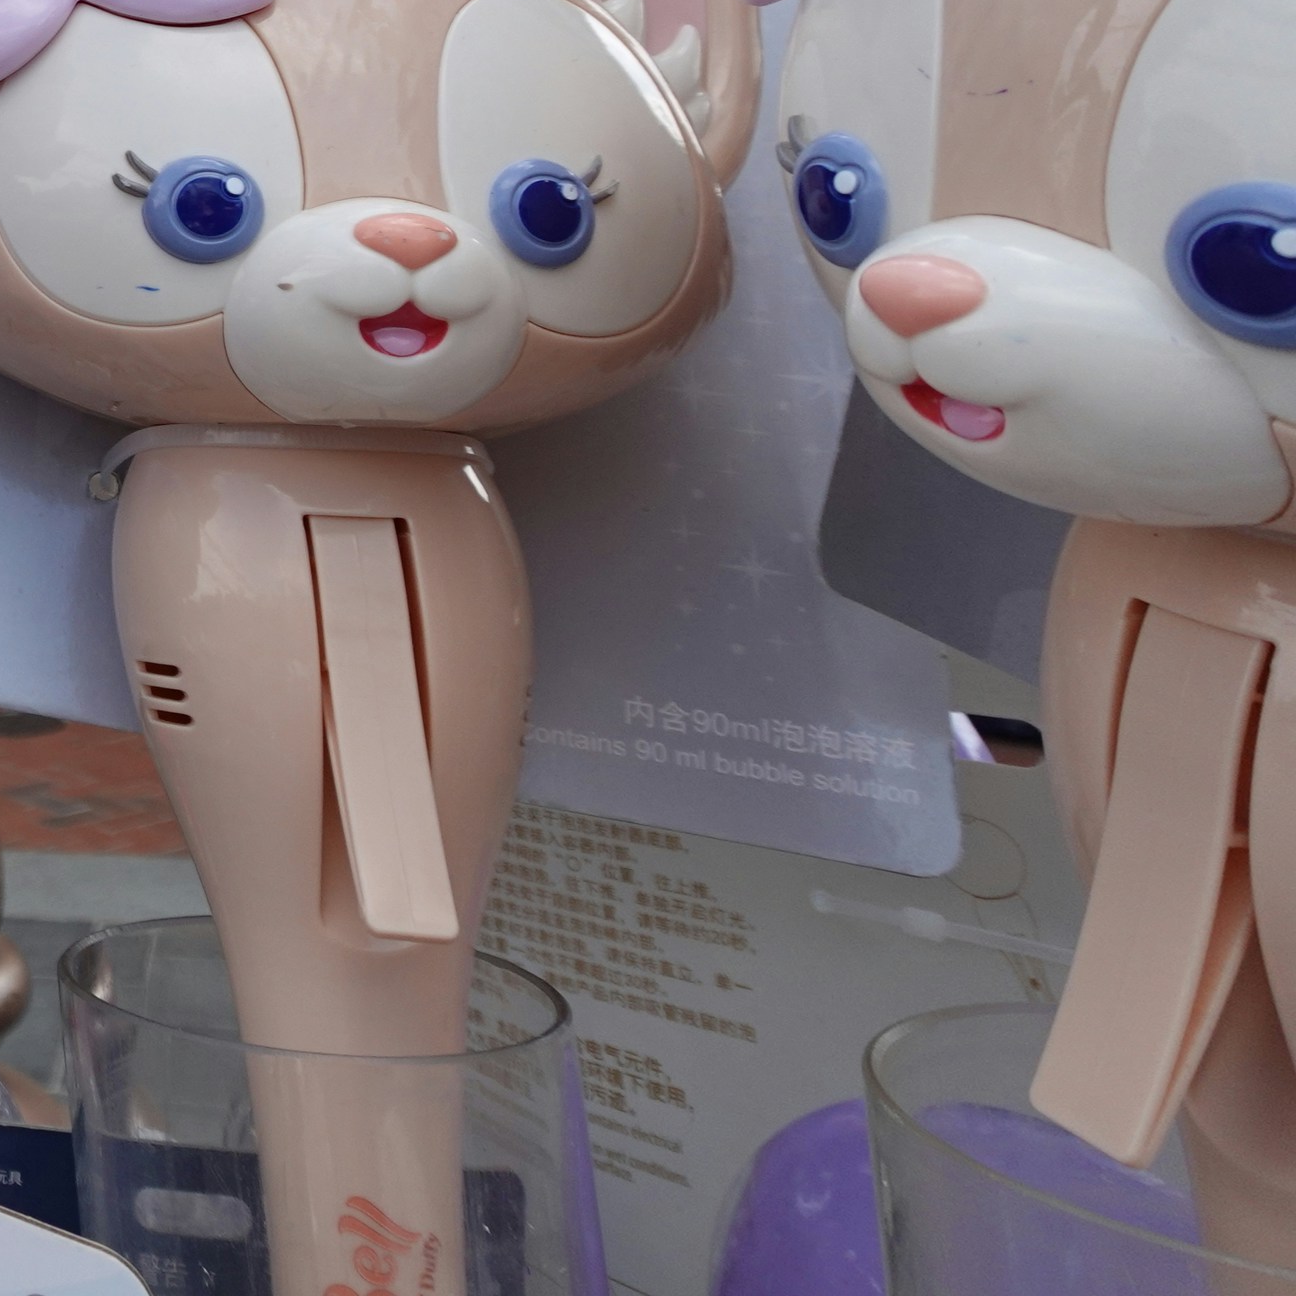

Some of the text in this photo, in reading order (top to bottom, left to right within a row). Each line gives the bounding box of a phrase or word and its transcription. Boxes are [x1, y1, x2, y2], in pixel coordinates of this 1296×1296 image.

[713, 750, 805, 787] bubble
[812, 769, 921, 805] solution
[419, 1232, 442, 1291] Duffy
